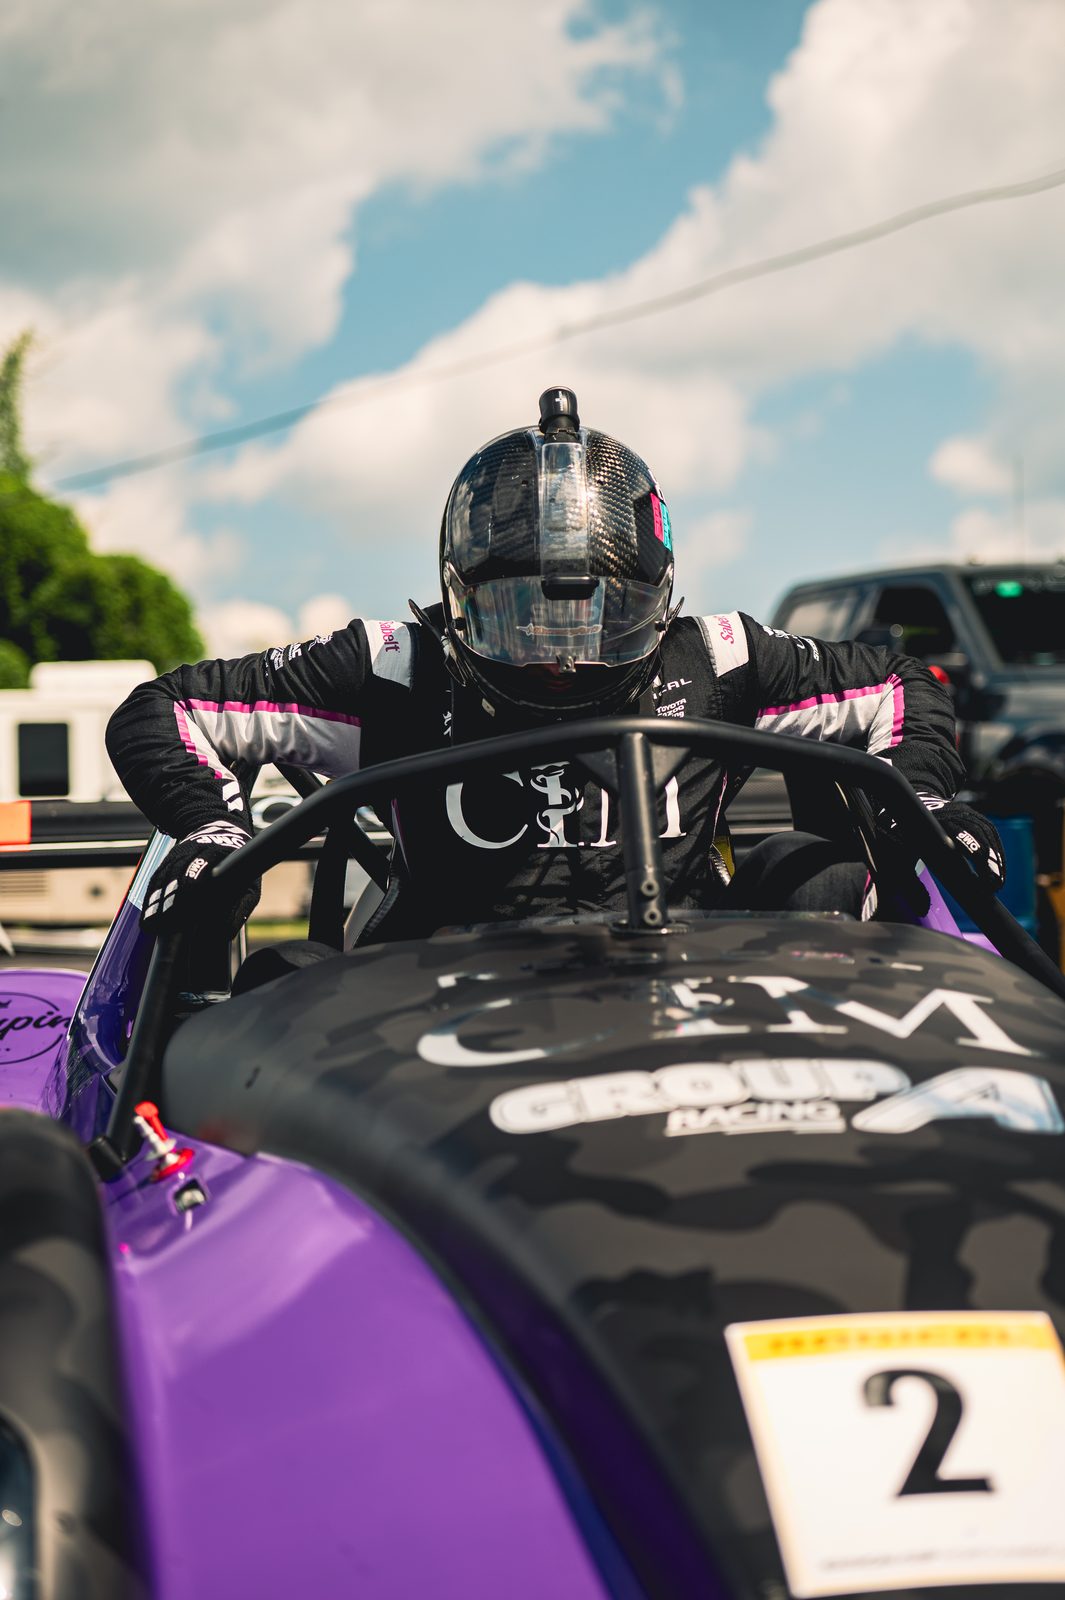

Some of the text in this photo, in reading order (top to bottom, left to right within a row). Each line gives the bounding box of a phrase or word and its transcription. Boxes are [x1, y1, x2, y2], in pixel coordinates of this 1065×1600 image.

[655, 698, 687, 713] TOYOTA
[957, 832, 980, 853] OMP
[187, 858, 206, 878] OMP
[489, 1058, 912, 1135] GROUP
[665, 1100, 848, 1137] RACING
[863, 1368, 995, 1499] 2
